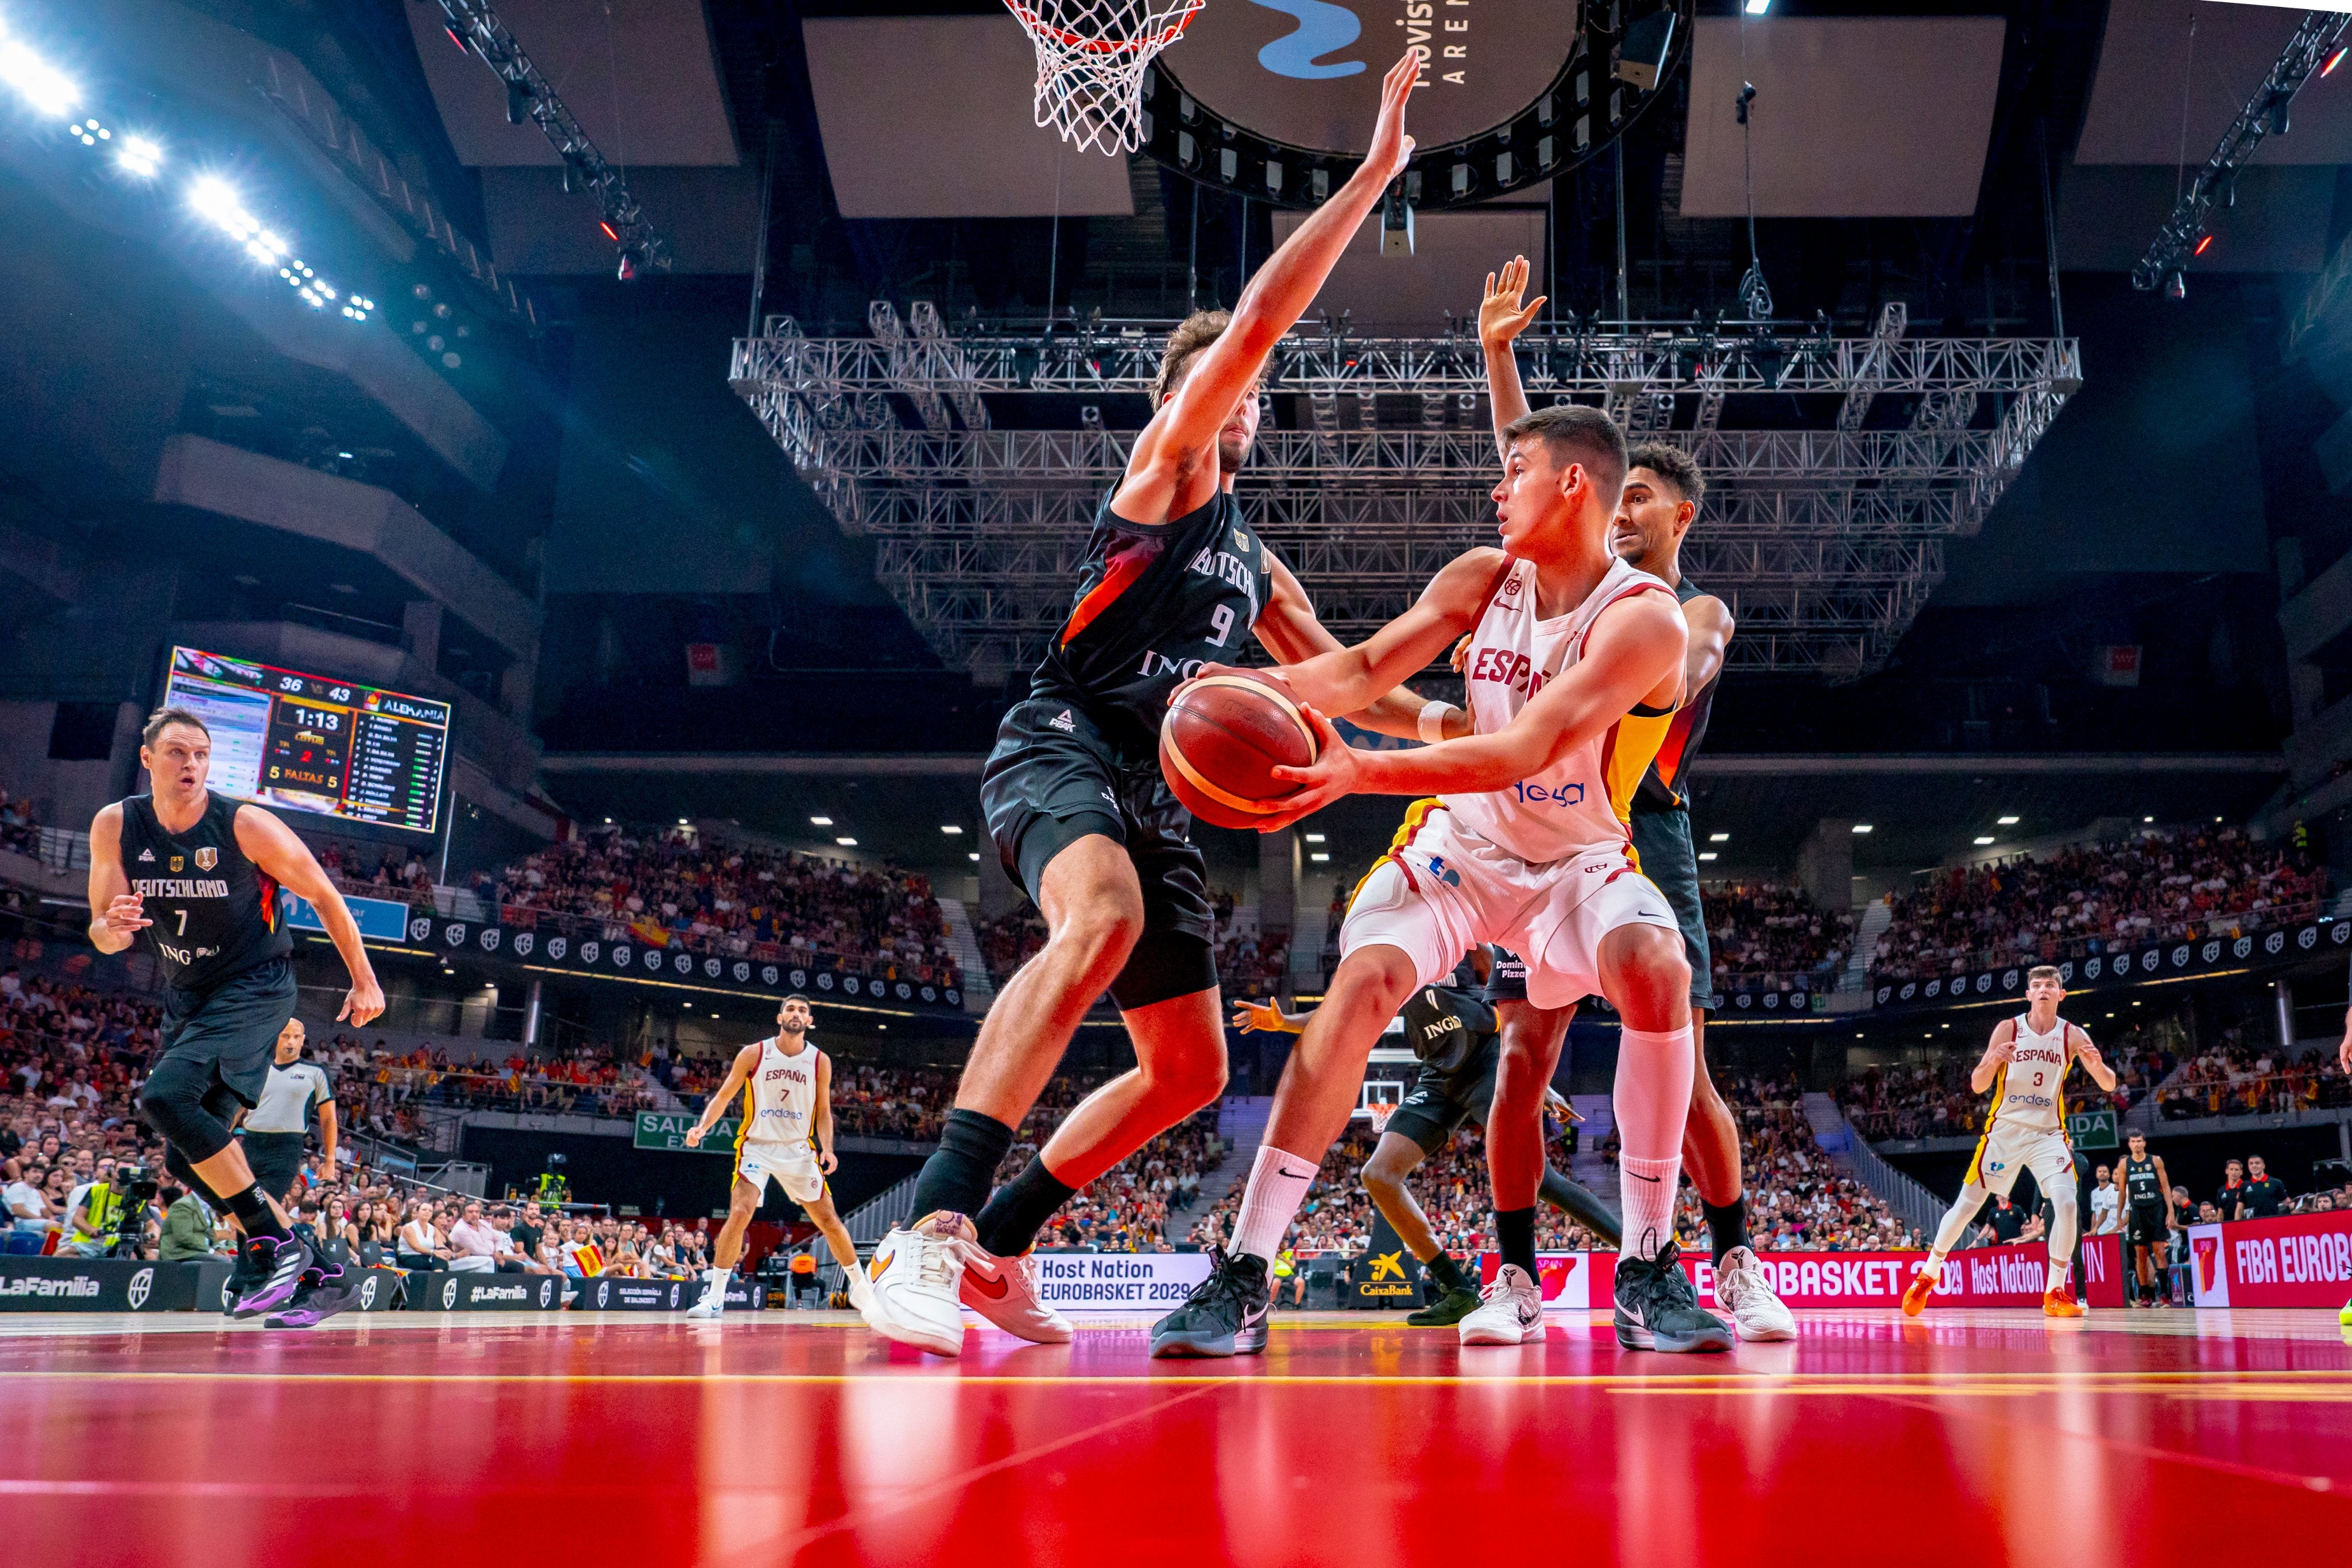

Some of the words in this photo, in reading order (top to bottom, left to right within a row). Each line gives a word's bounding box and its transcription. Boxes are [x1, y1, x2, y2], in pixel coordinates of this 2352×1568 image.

[1205, 603, 1235, 648] 9
[279, 676, 303, 692] 36
[328, 687, 350, 702] 43
[384, 699, 445, 721] ALEMANIA
[295, 708, 339, 731] 1:13
[1049, 717, 1076, 733] PEAK
[300, 750, 312, 762] 2
[269, 765, 280, 779] 5
[284, 768, 324, 785] FALTAS
[327, 776, 338, 788] 5
[131, 879, 229, 897] DEUTSCHLAND
[175, 910, 187, 936] 7
[158, 942, 191, 965] ING
[1423, 1018, 1454, 1040] ING
[2016, 1050, 2061, 1066] ESPAÑA
[765, 1069, 806, 1085] ESPAÑA
[2033, 1072, 2043, 1086] 3
[780, 1089, 790, 1101] 7
[2009, 1094, 2052, 1107] endes
[761, 1108, 802, 1120] endesa
[667, 1135, 707, 1149] EXT
[2140, 1182, 2146, 1191] 5
[2235, 1238, 2278, 1284] FIBA
[2280, 1233, 2352, 1284] EUROB
[1042, 1260, 1085, 1278] Host
[1092, 1260, 1153, 1278] Nation
[1695, 1260, 1902, 1296] EOBASKET
[1971, 1257, 1999, 1294] Host
[2001, 1253, 2044, 1294] Nation
[471, 1285, 527, 1302] #LaFamilia
[1041, 1283, 1145, 1300] EUROBASKET
[1150, 1283, 1191, 1300] 2029
[1360, 1284, 1414, 1296] CaixaBank
